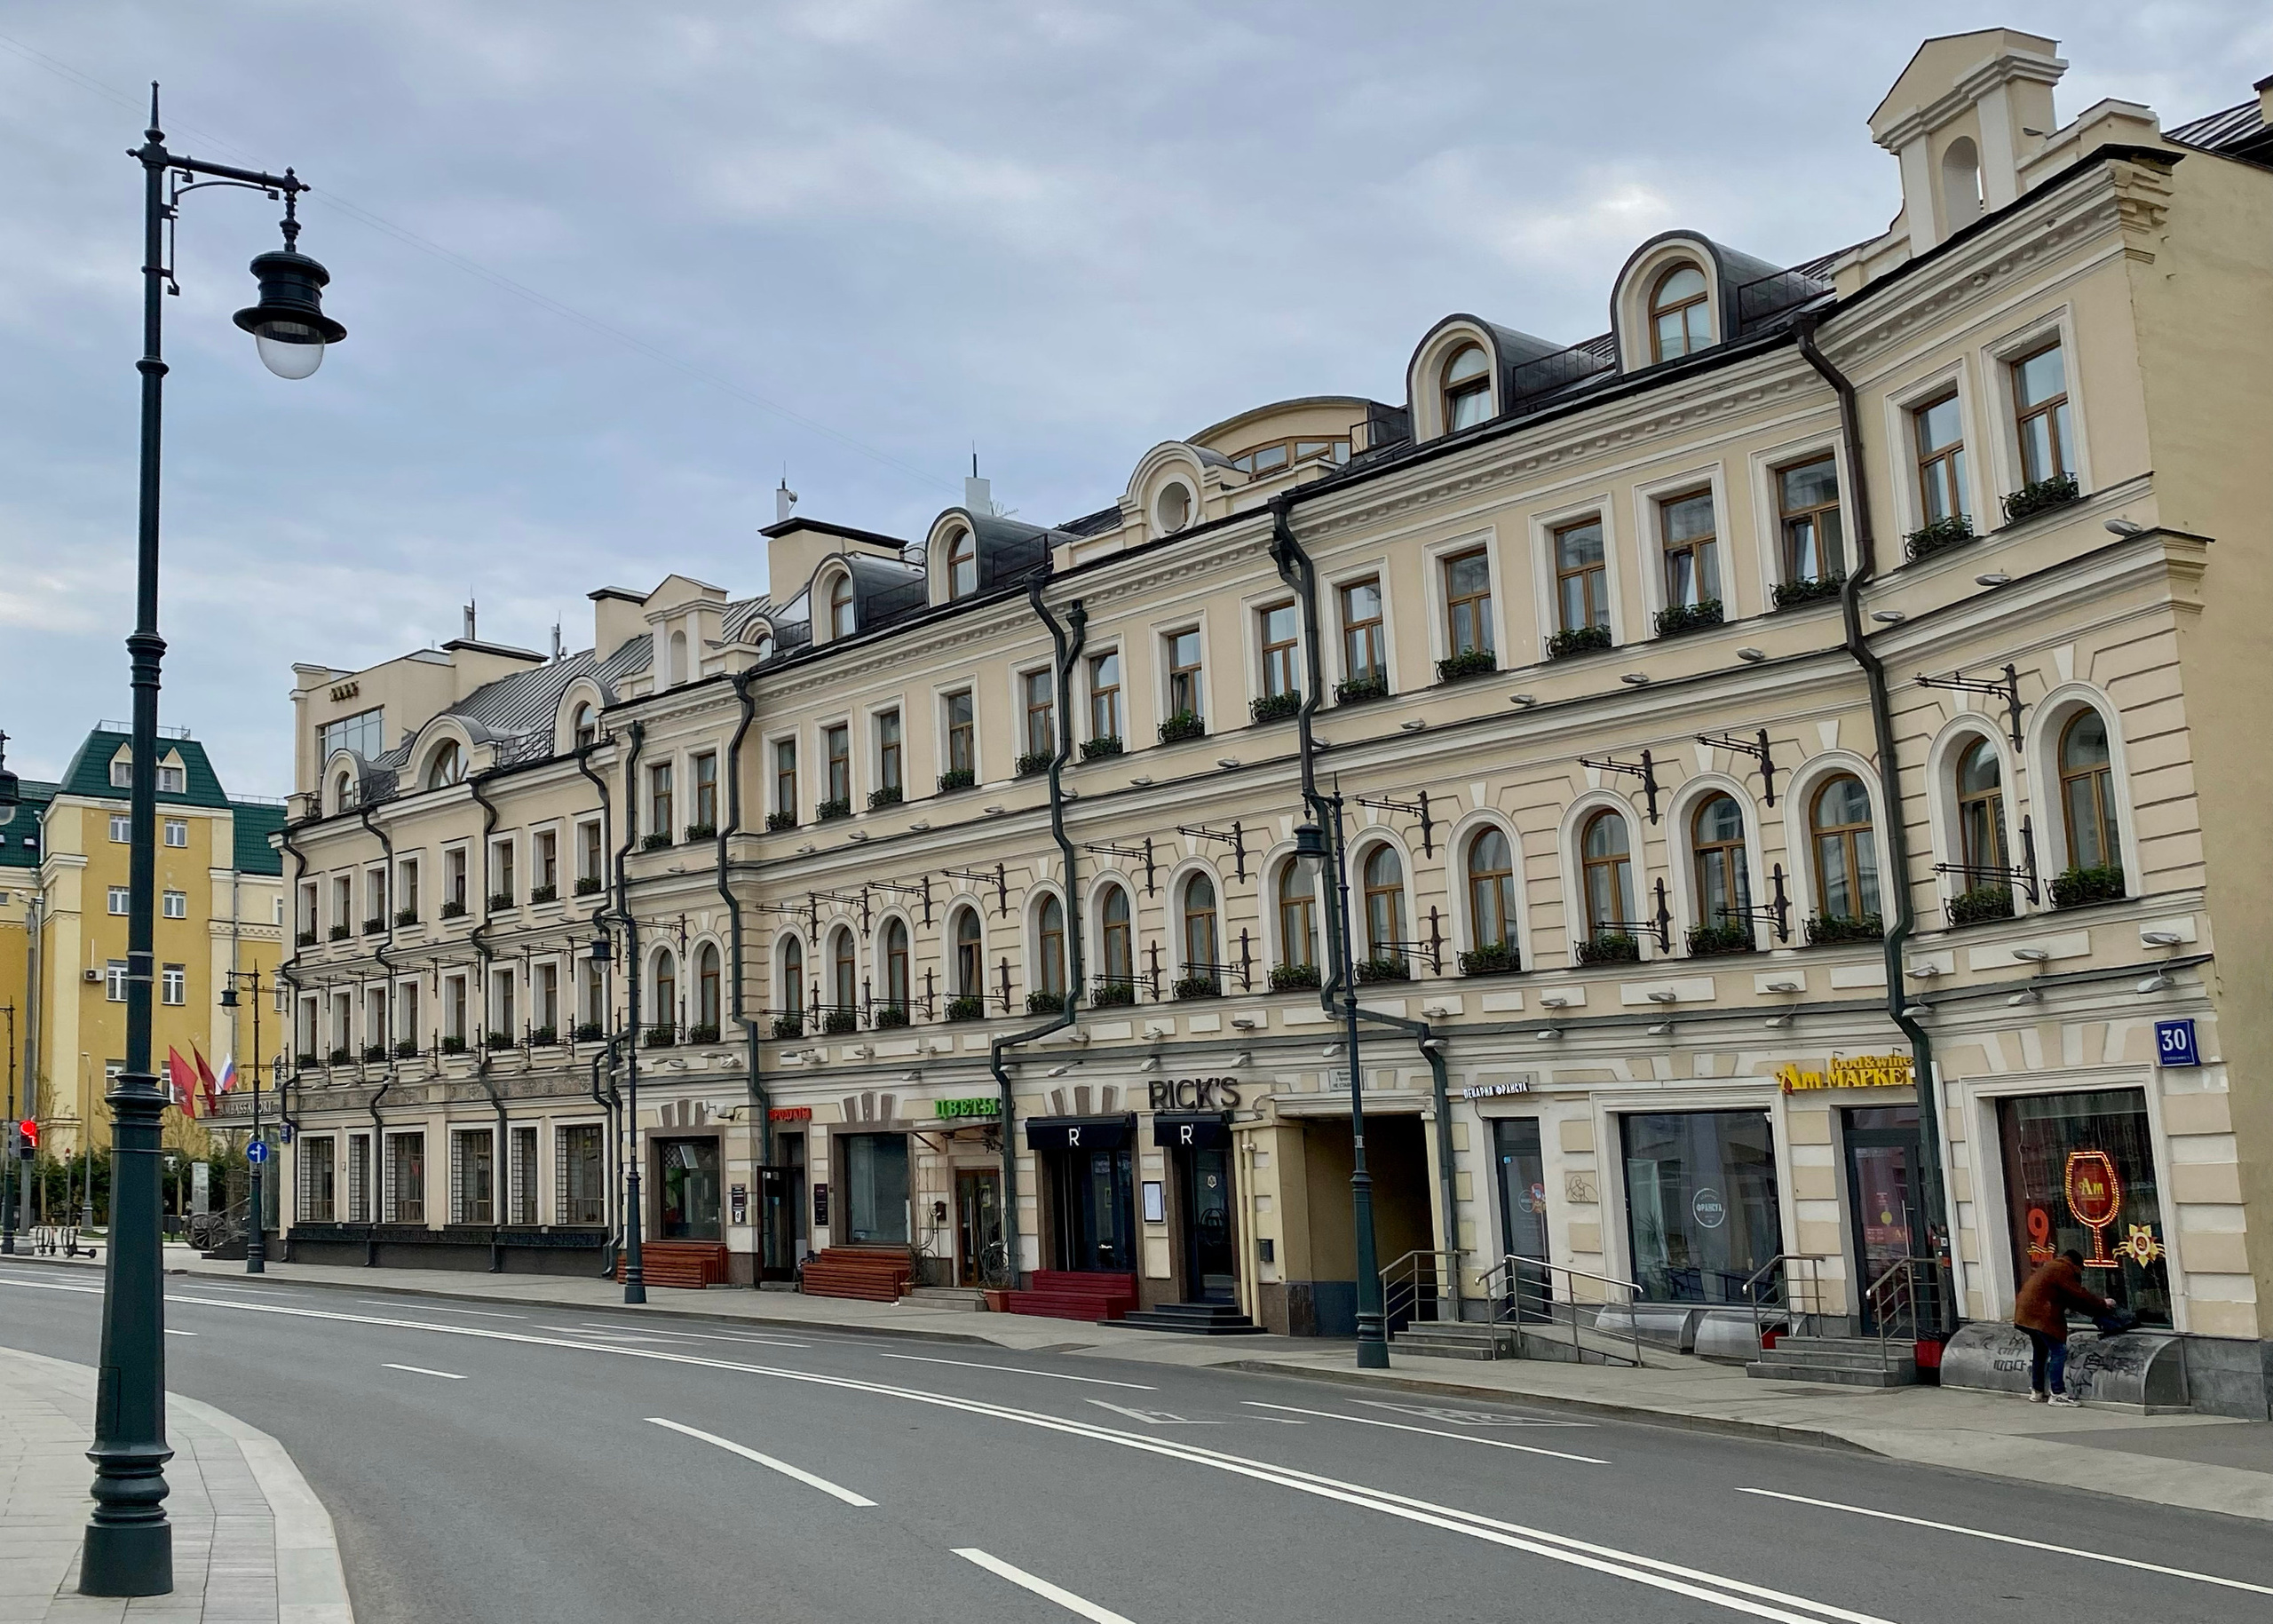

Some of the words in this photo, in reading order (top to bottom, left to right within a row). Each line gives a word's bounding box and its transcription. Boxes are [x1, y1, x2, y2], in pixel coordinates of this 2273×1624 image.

[2161, 1028, 2187, 1051] 30
[1148, 1077, 1240, 1110] RICK'S
[1496, 1082, 1528, 1095] ФРАНСУА
[219, 1101, 273, 1115] AMBASSAORI
[769, 1107, 811, 1121] ПРОДУКТЫ
[934, 1097, 998, 1119] ЦВЕТЫ
[2028, 1208, 2049, 1248] 9
